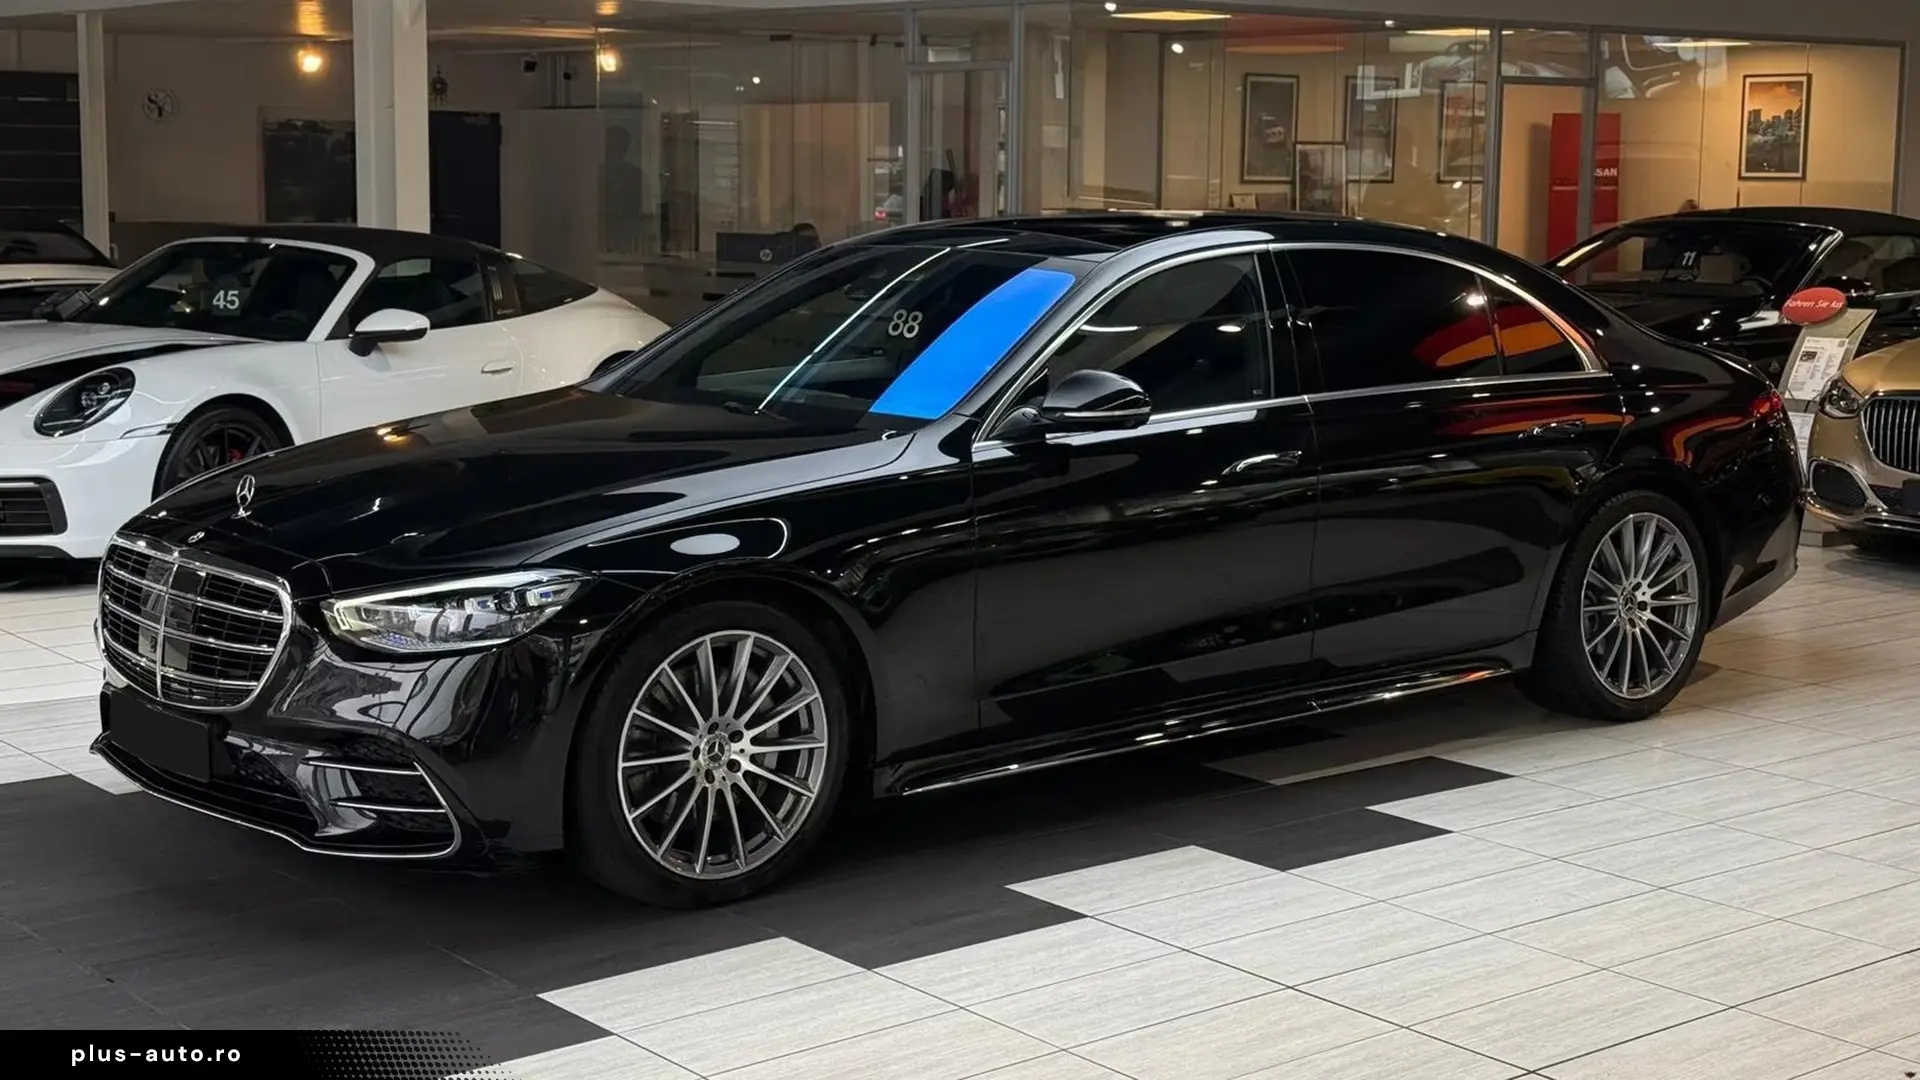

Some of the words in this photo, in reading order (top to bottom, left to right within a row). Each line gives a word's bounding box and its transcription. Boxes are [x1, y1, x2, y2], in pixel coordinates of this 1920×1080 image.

[1595, 167, 1618, 177] SAN
[1682, 251, 1697, 266] 11
[213, 290, 239, 309] 45
[888, 309, 923, 338] 88
